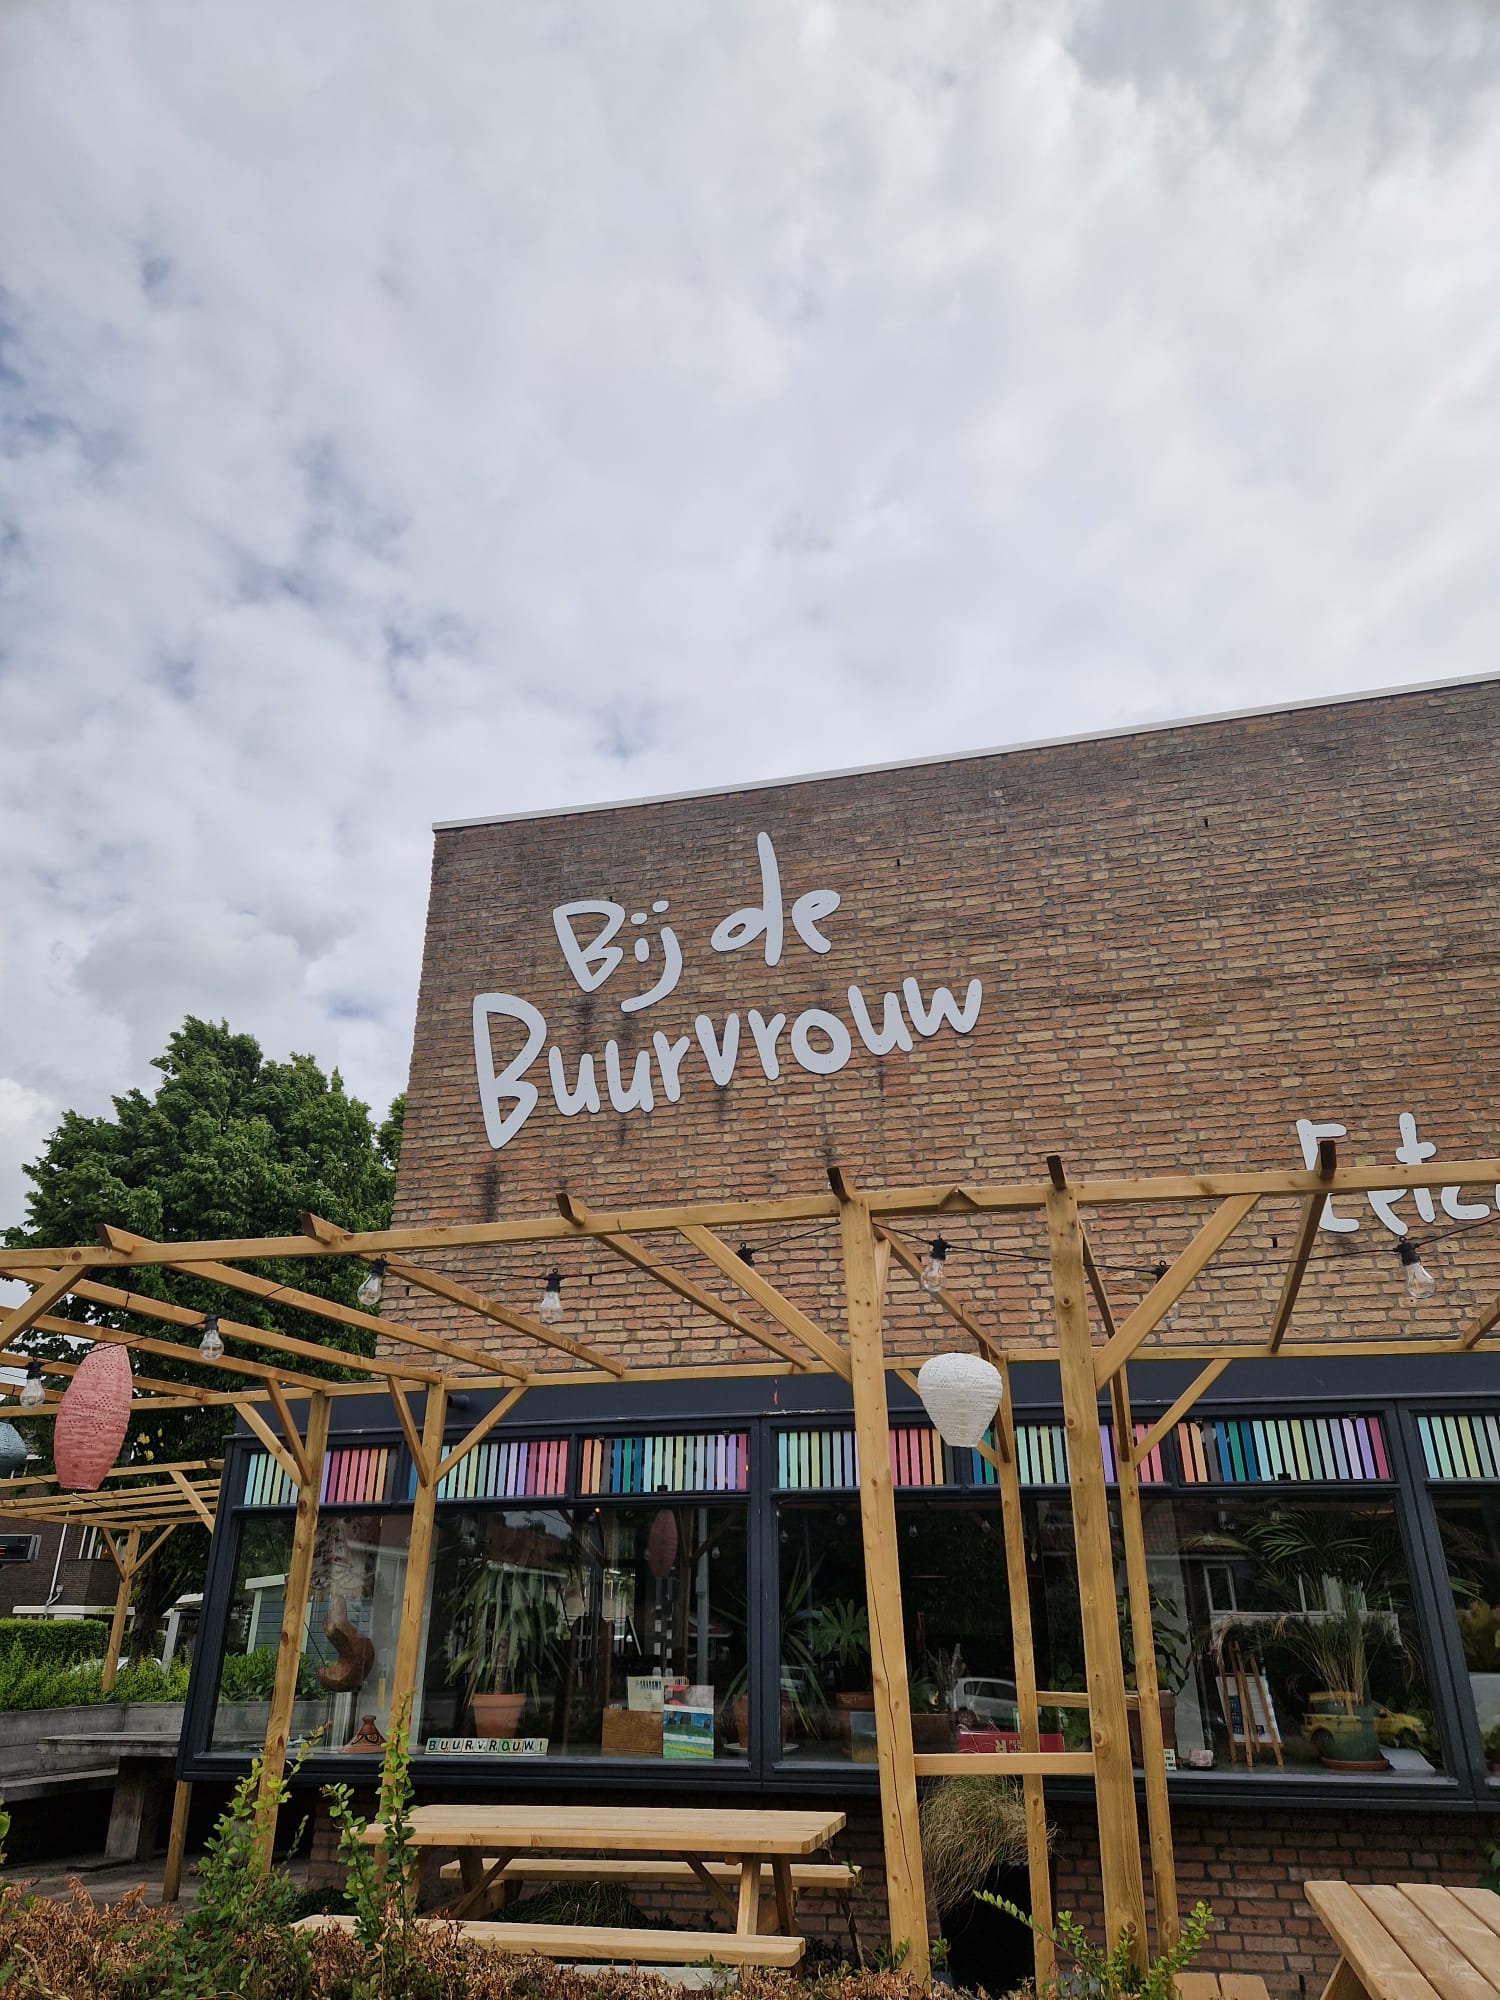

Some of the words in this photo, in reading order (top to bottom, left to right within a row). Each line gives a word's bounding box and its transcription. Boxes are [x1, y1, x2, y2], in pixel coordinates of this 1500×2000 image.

[553, 900, 683, 1012] Bij
[711, 831, 841, 966] de
[472, 976, 983, 1150] Buurvrouw
